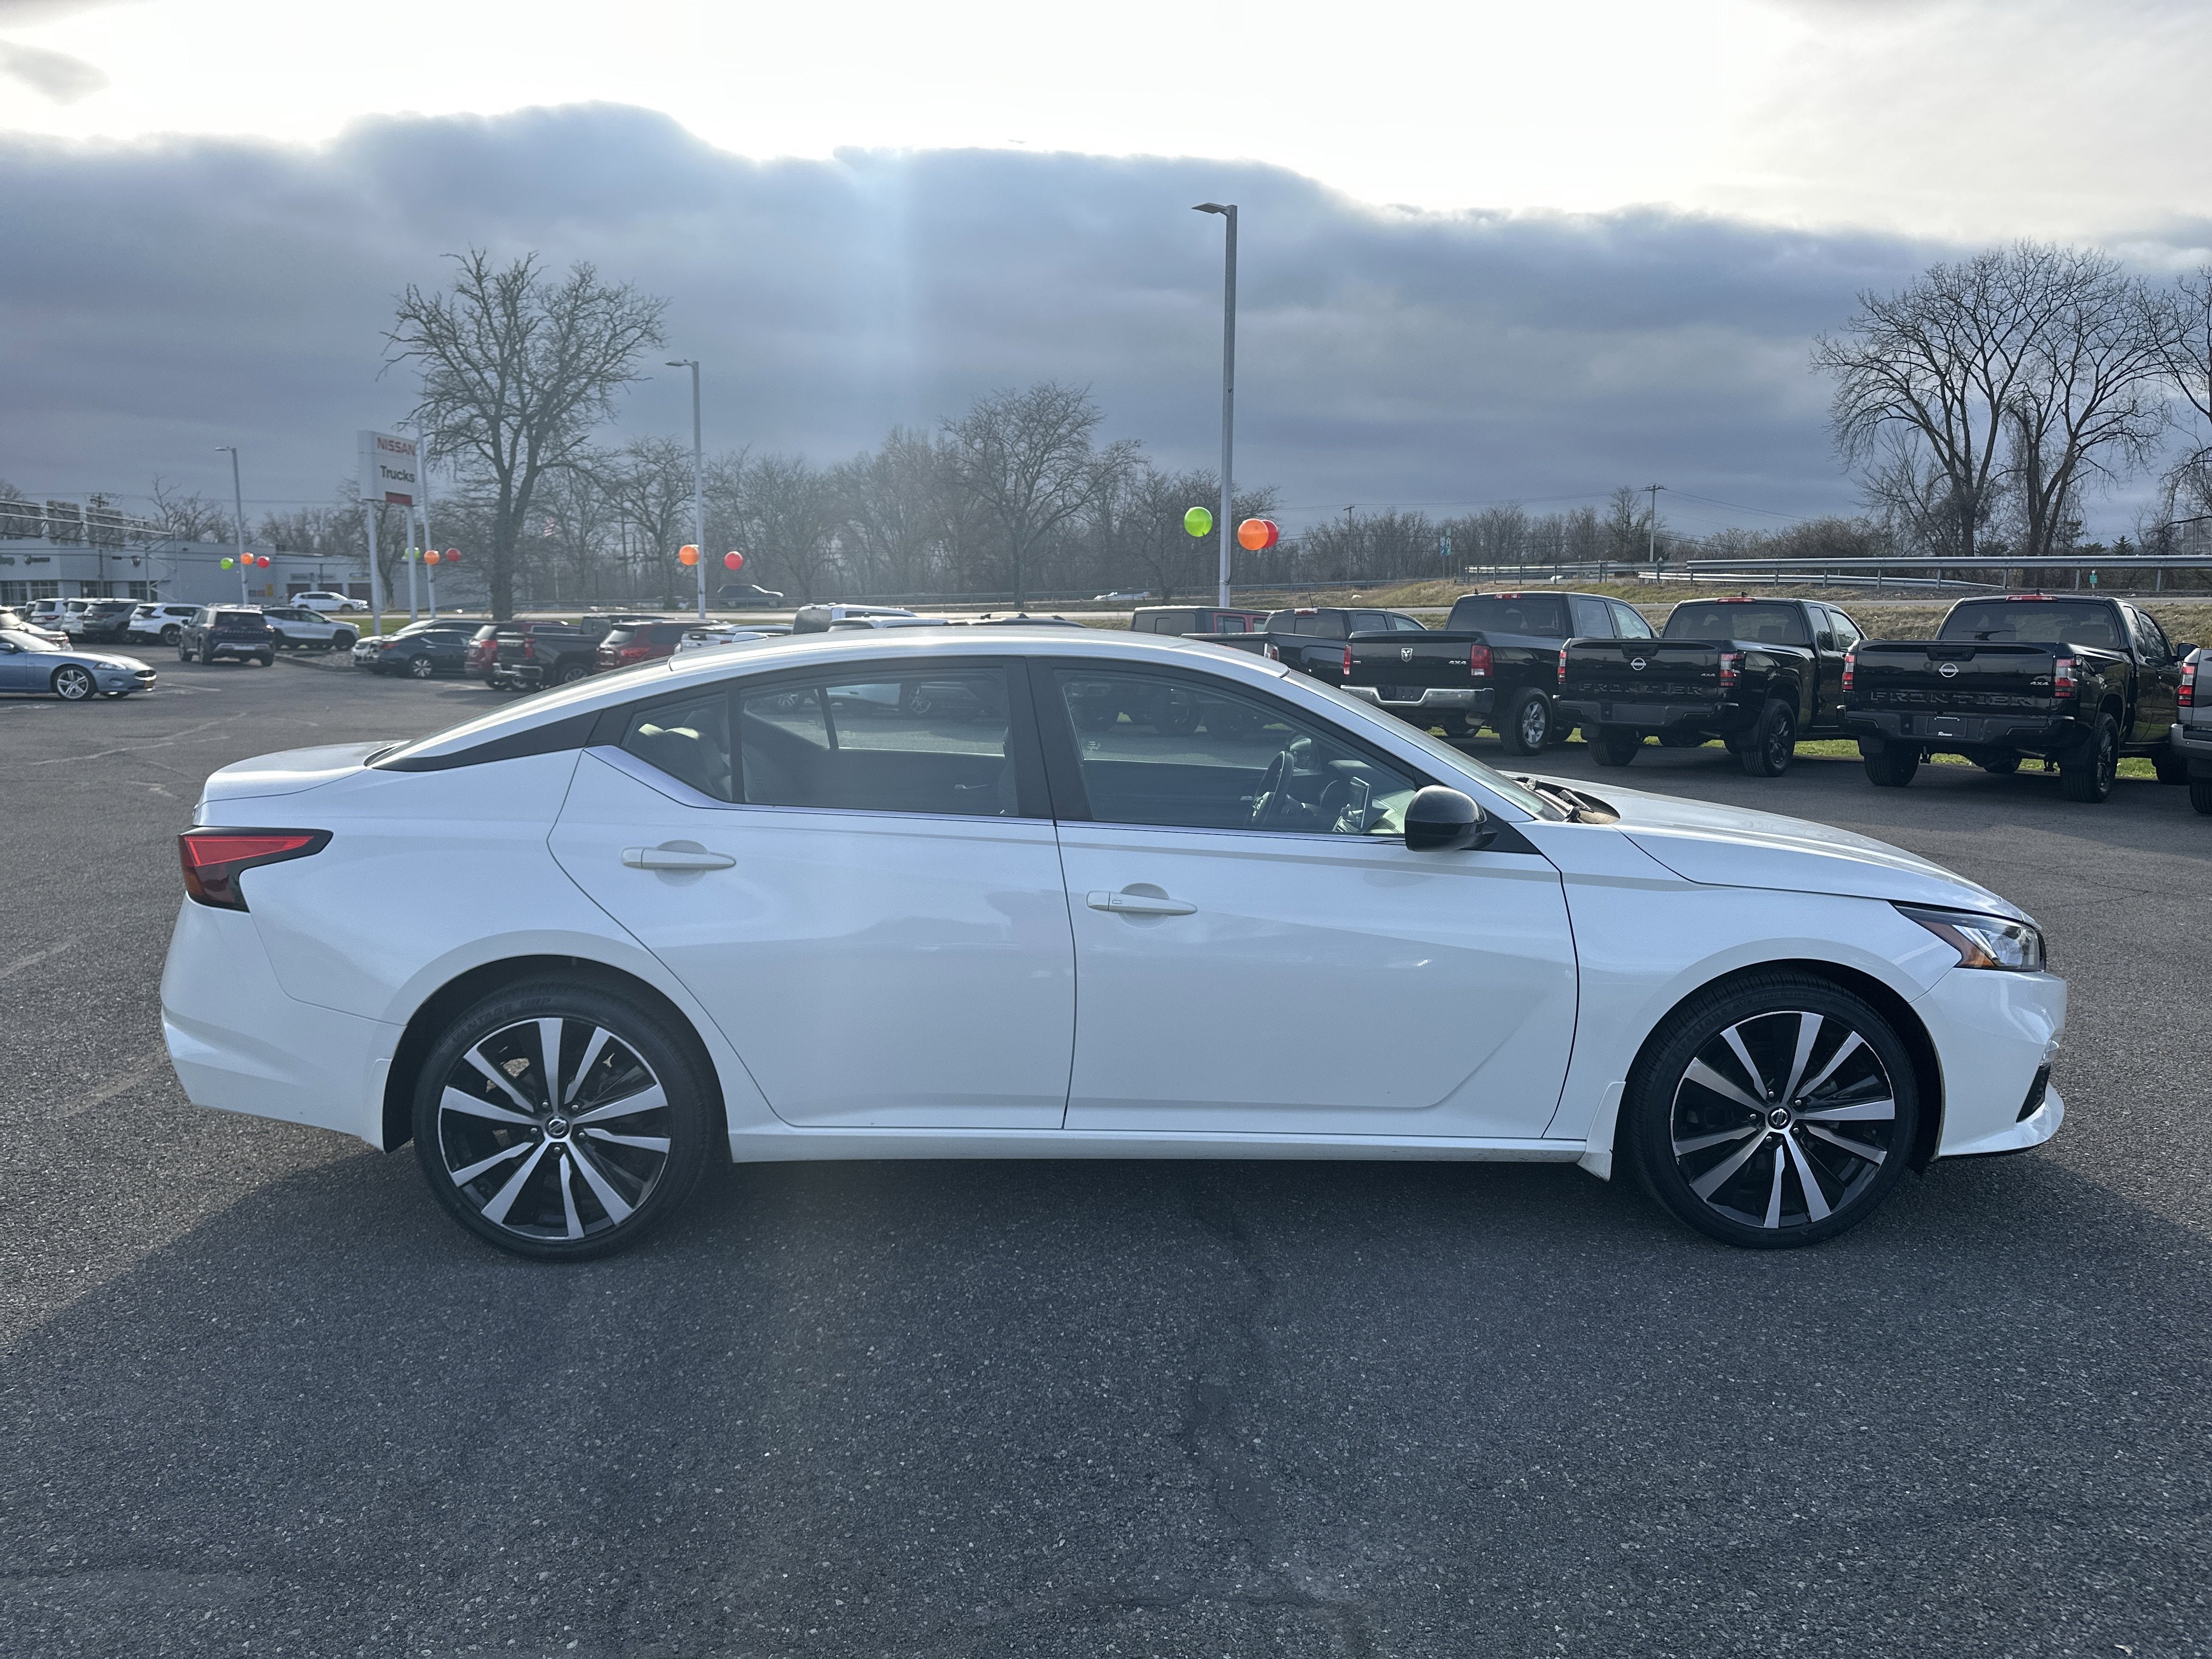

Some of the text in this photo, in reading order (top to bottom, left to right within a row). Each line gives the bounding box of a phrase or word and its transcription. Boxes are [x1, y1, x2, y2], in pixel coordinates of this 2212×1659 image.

[377, 437, 416, 456] NISSAN
[380, 465, 415, 483] Trucks
[1578, 683, 1704, 696] FRONTIER
[1870, 691, 2033, 707] FRONTIER
[451, 996, 552, 1042] VANTAGE UHP
